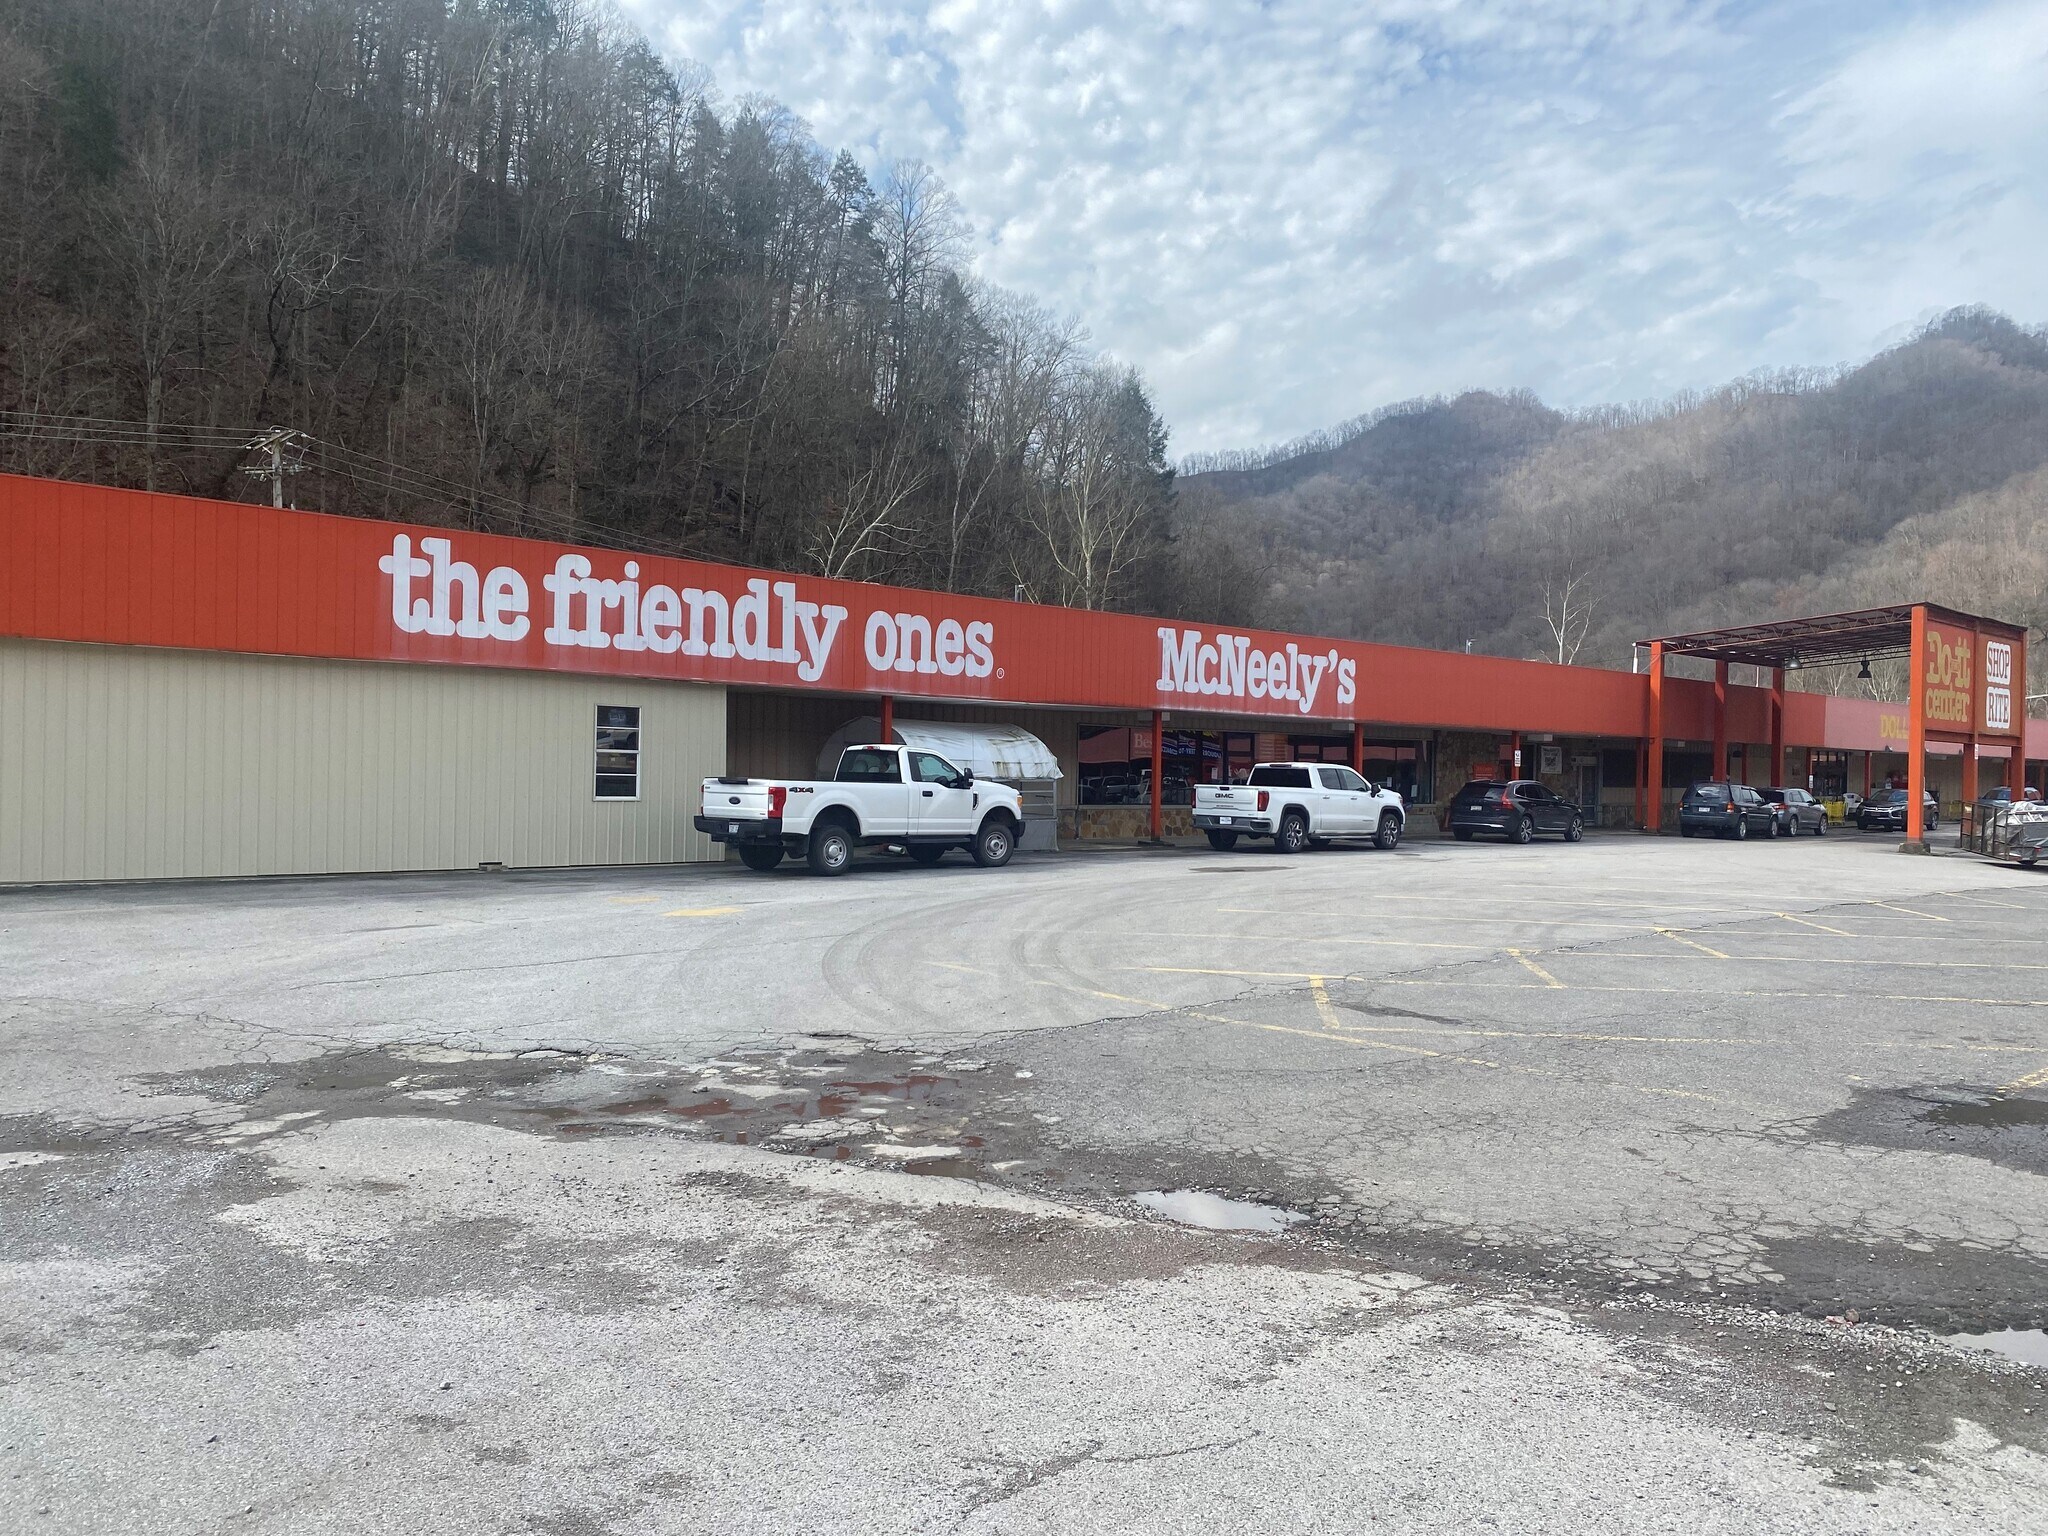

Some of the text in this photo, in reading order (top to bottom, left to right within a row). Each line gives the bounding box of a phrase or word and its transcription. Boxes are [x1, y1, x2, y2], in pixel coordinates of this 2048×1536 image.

[379, 534, 530, 641] the
[543, 554, 847, 681] friendly
[864, 611, 993, 677] ones
[1156, 627, 1356, 713] McNeely's
[1987, 648, 2010, 679] SHOP
[1926, 682, 1970, 722] center
[1987, 692, 2010, 724] RITE
